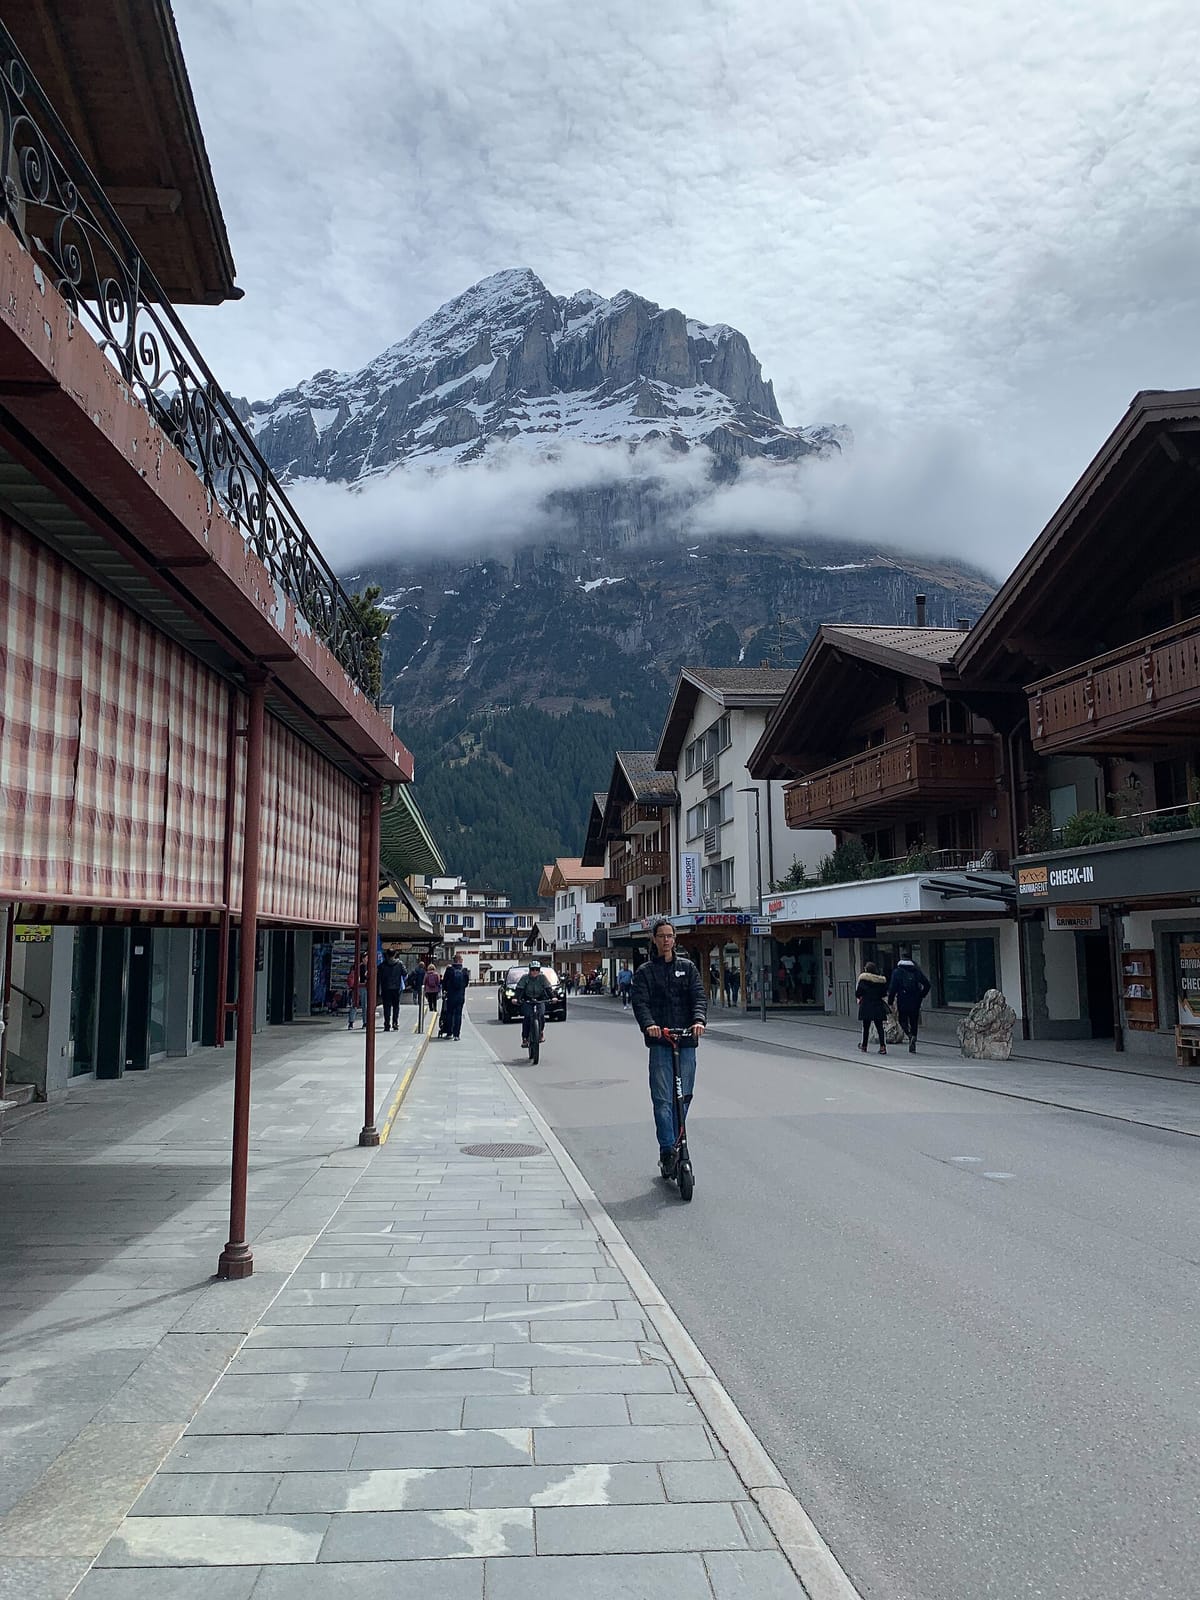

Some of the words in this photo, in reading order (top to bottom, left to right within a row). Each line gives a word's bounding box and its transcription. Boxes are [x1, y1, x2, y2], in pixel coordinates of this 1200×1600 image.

[1050, 866, 1094, 886] CHECK-IN
[706, 914, 751, 925] INTERSP
[20, 934, 46, 942] DEPOT
